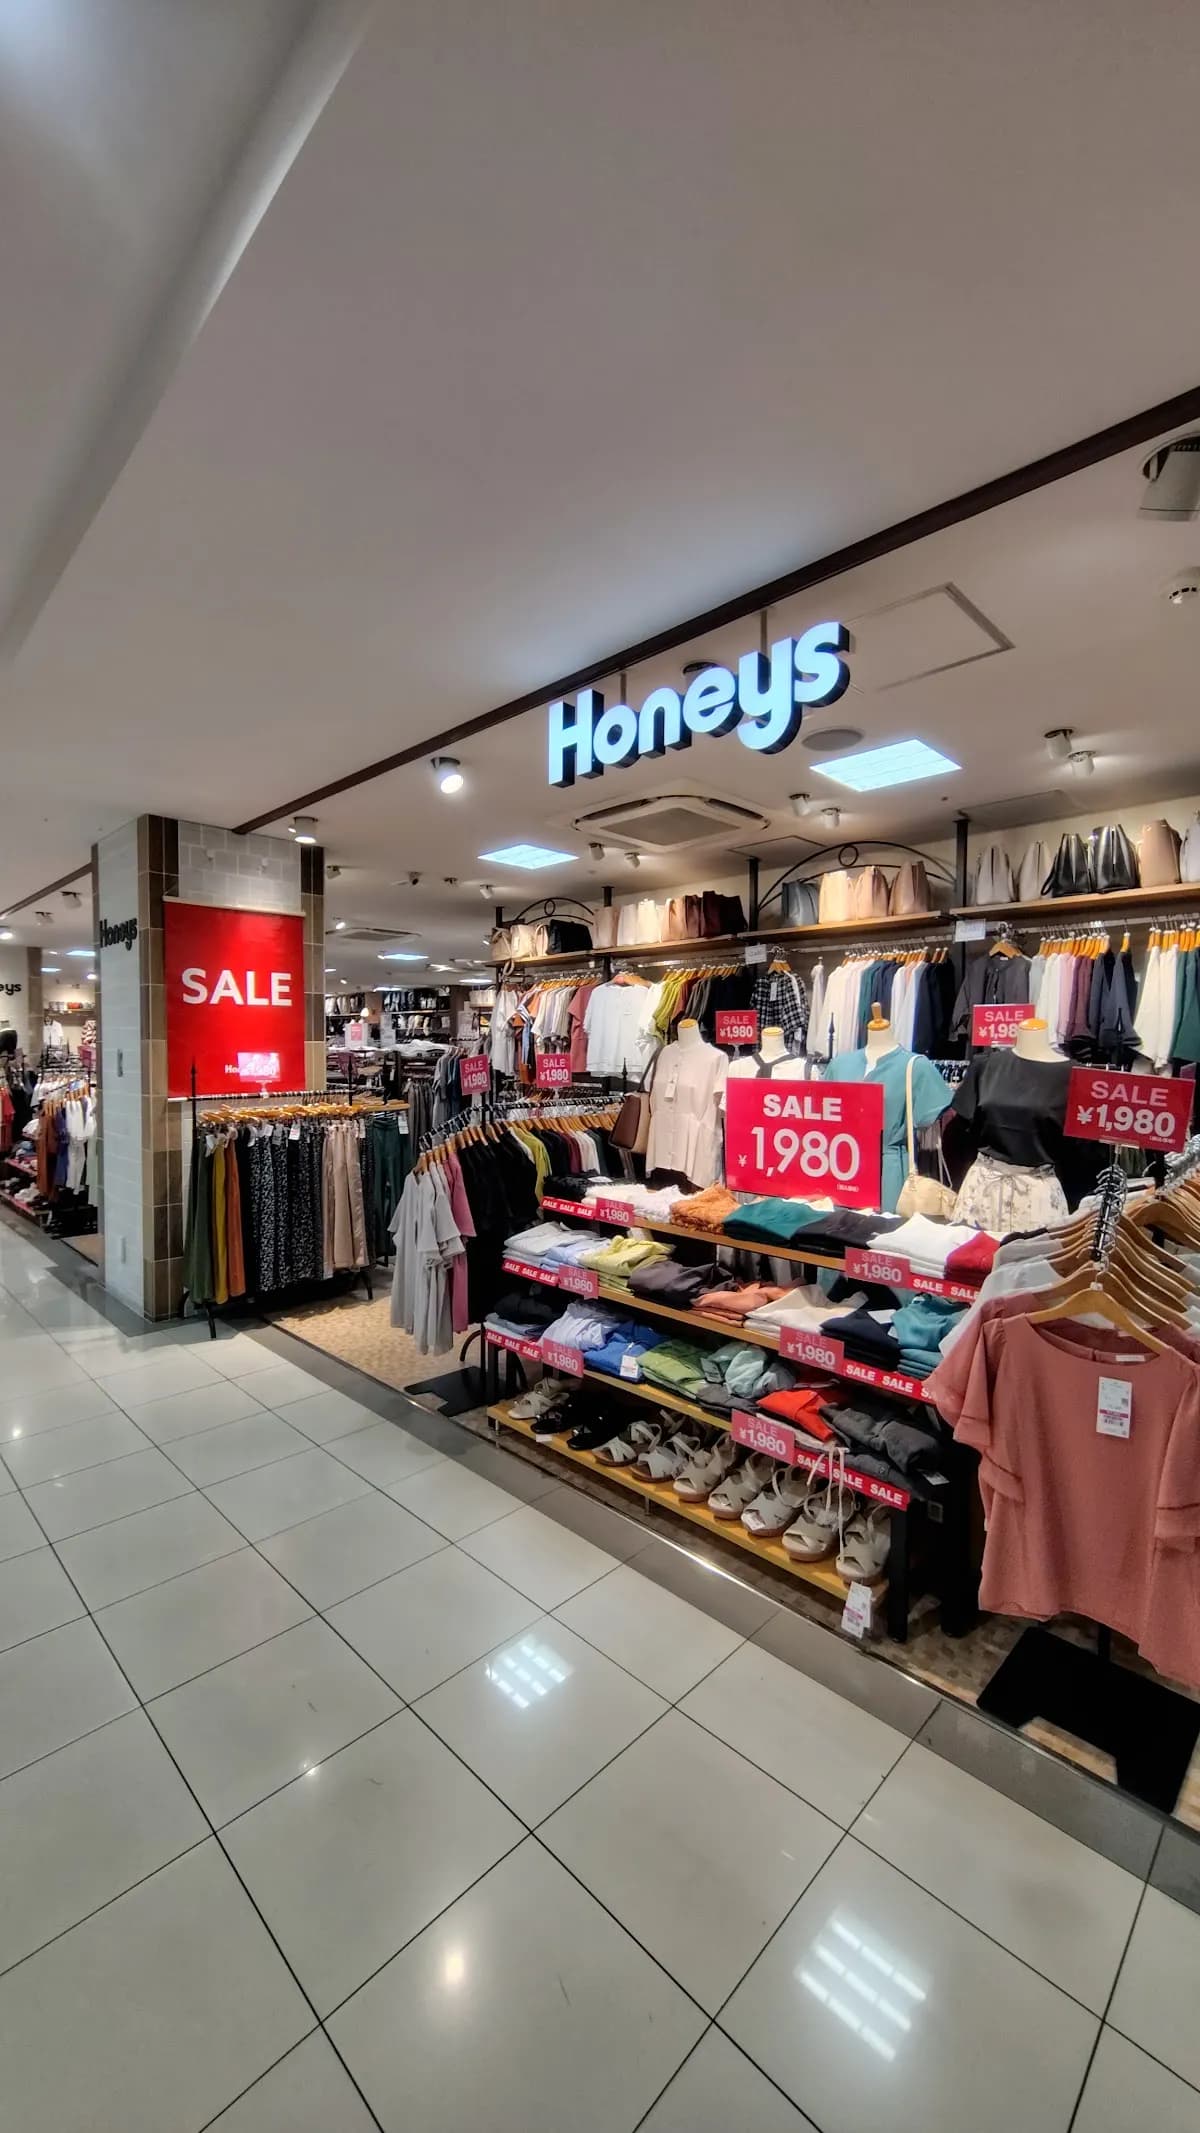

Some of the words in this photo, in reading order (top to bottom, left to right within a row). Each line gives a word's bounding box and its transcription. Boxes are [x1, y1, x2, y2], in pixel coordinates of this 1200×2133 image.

[549, 621, 850, 787] Honeys
[99, 918, 138, 950] Honeys
[182, 967, 292, 1006] SALE
[723, 1015, 750, 1025] SALE
[984, 1010, 1024, 1022] SALE
[720, 1025, 753, 1039] ¥1,980
[978, 1023, 1018, 1039] ¥1,98
[464, 1060, 483, 1073] SALE
[543, 1058, 565, 1068] SALE
[540, 1068, 569, 1082] ¥1,980
[1090, 1080, 1169, 1107] SALE
[763, 1094, 842, 1122] SALE
[1077, 1104, 1175, 1137] ¥1,980
[542, 1199, 557, 1208] SALE
[560, 1203, 574, 1213] SALE
[577, 1207, 593, 1217] SALE
[605, 1201, 625, 1211] SALE
[862, 1251, 892, 1267] SALE
[504, 1262, 520, 1273] SALE
[522, 1267, 538, 1278] SALE
[540, 1272, 556, 1283] SALE
[568, 1268, 587, 1280] SALE
[853, 1261, 902, 1283] ¥1,980
[913, 1278, 944, 1293] SALE
[487, 1332, 502, 1343] SALE
[505, 1338, 520, 1351] SALE
[522, 1345, 539, 1358] SALE
[795, 1331, 827, 1349] SALE
[787, 1342, 836, 1366] ¥1,980
[846, 1364, 876, 1382] SALE
[882, 1375, 914, 1394] SALE
[747, 1417, 778, 1438] SALE
[740, 1427, 787, 1456] ¥1,980
[870, 1483, 903, 1505] SALE
